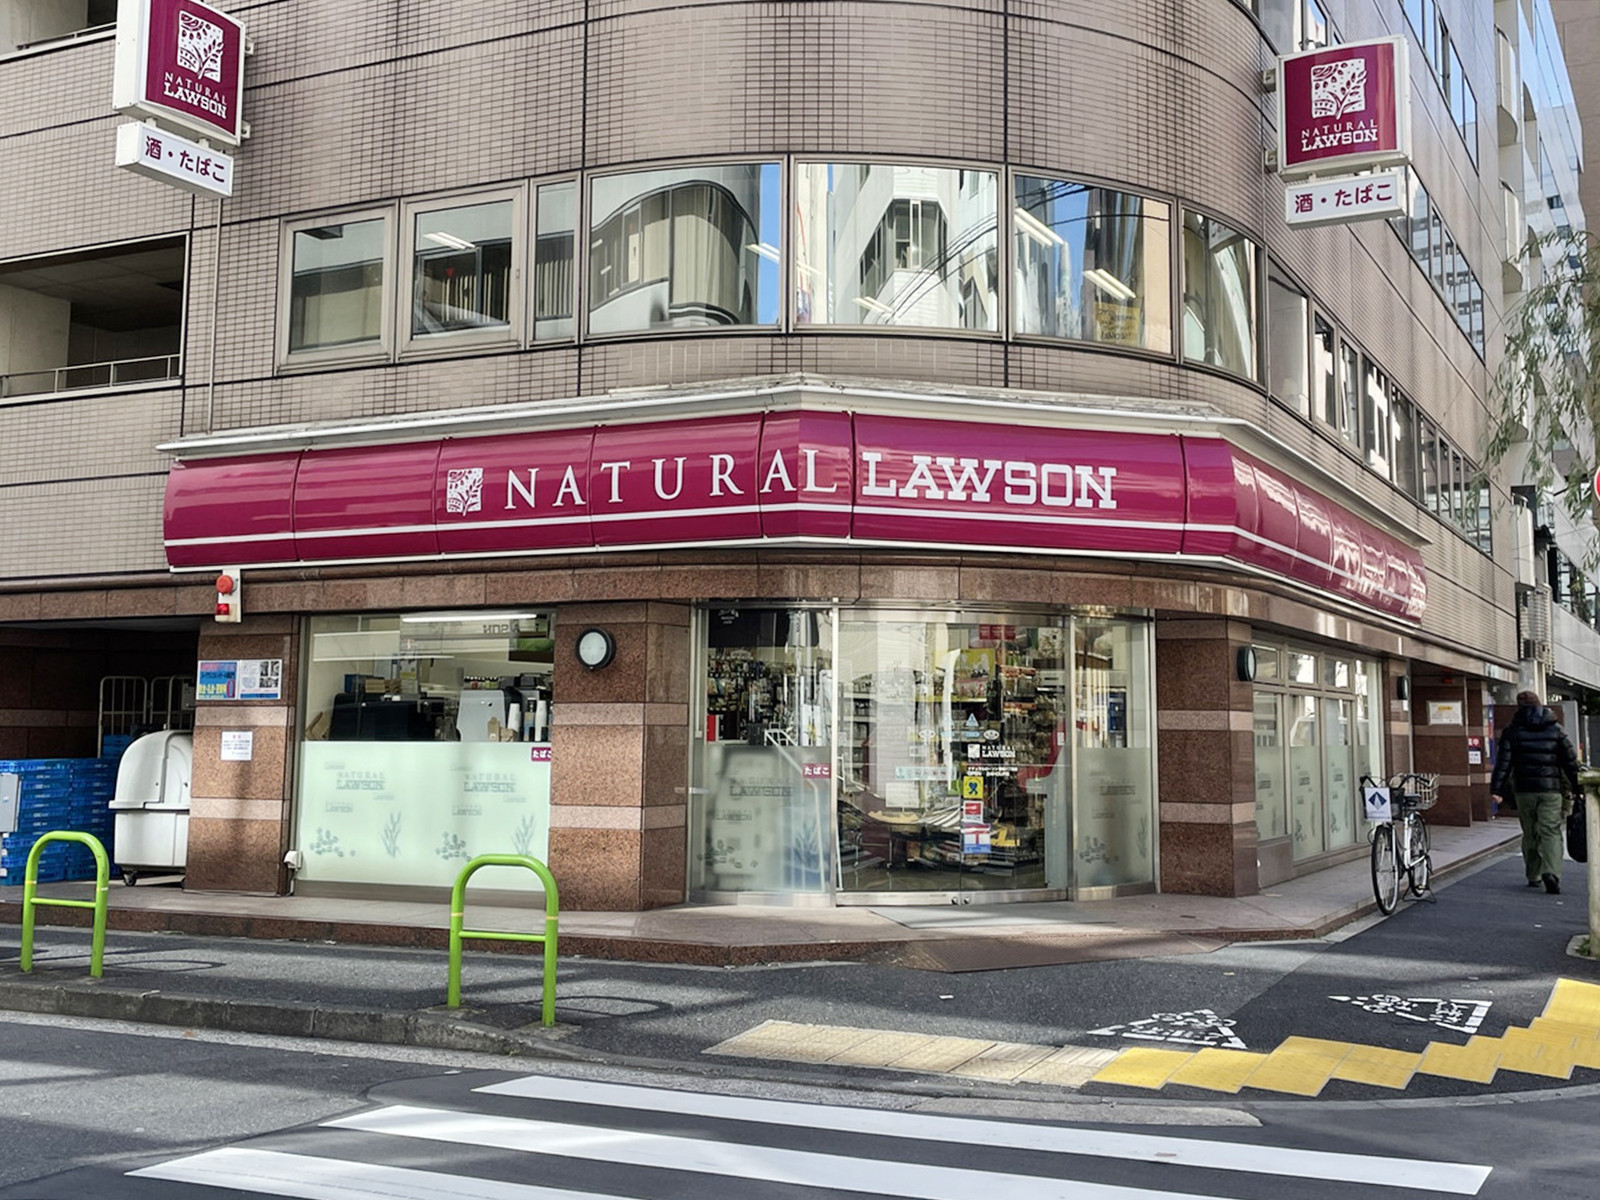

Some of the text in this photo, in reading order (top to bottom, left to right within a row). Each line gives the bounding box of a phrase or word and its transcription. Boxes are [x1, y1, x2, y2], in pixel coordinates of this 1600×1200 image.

[163, 82, 227, 119] LAWSON
[165, 72, 227, 105] NATURAL
[1301, 119, 1378, 138] NATURAL
[1301, 129, 1378, 152] LAWSON
[146, 135, 225, 183] 酒・たばこ
[1295, 183, 1392, 213] 酒・たばこ
[504, 449, 1117, 510] NATURAL LAWSON
[804, 766, 829, 775] たばこ
